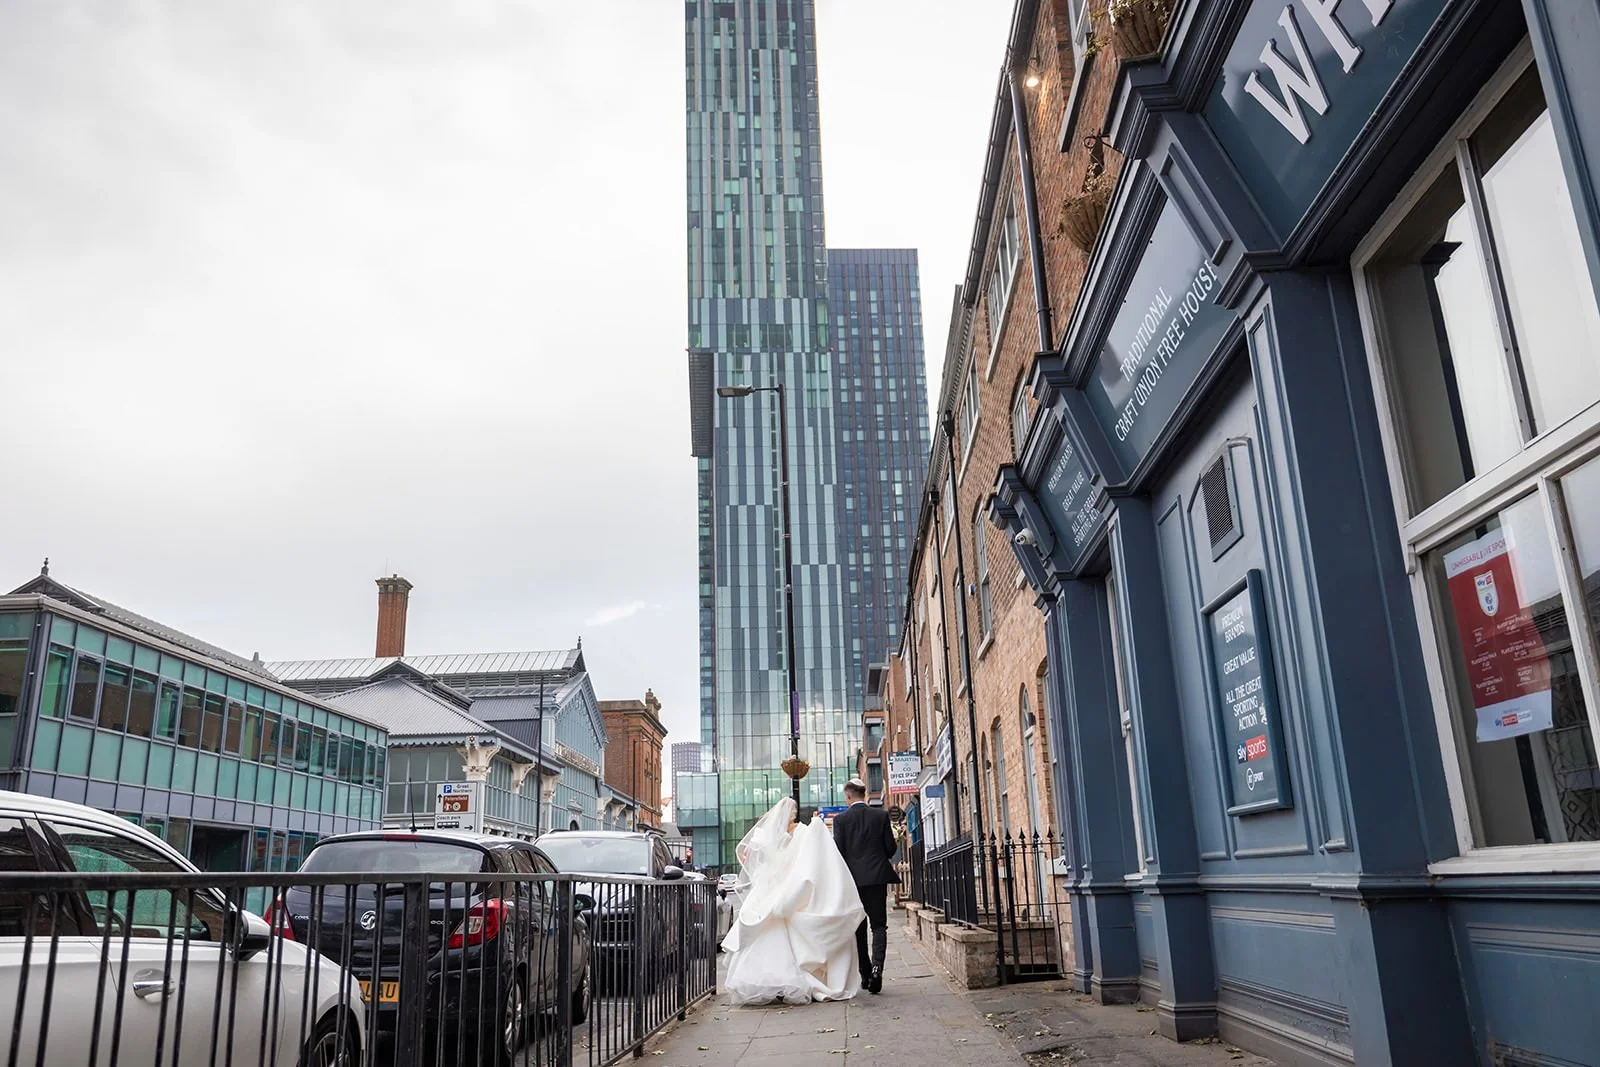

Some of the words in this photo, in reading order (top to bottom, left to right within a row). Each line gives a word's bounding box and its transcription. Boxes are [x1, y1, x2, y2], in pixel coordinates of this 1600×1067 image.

[1119, 286, 1172, 382] TRADITIONAL
[1114, 398, 1139, 442] CRAFT
[1134, 356, 1163, 406] UNION
[1156, 318, 1186, 367] FREE
[1062, 489, 1075, 511] GREAT
[1071, 471, 1084, 494] VALUE
[1071, 521, 1080, 536] ALL
[1077, 508, 1087, 525] THE
[1083, 490, 1097, 514] GREAT
[1222, 605, 1244, 629] PREMIUM
[1224, 620, 1245, 643] BRANDS
[1223, 655, 1240, 675] GREAT
[1238, 646, 1256, 666] VALUE
[1225, 690, 1236, 704] ALL
[1235, 685, 1246, 699] THE
[1245, 676, 1262, 695] GREAT
[1233, 695, 1259, 717] SPORTING
[1238, 712, 1258, 731] ACTION
[1237, 745, 1247, 761] sky
[1247, 739, 1267, 759] sports
[1253, 771, 1264, 783] SPORT
